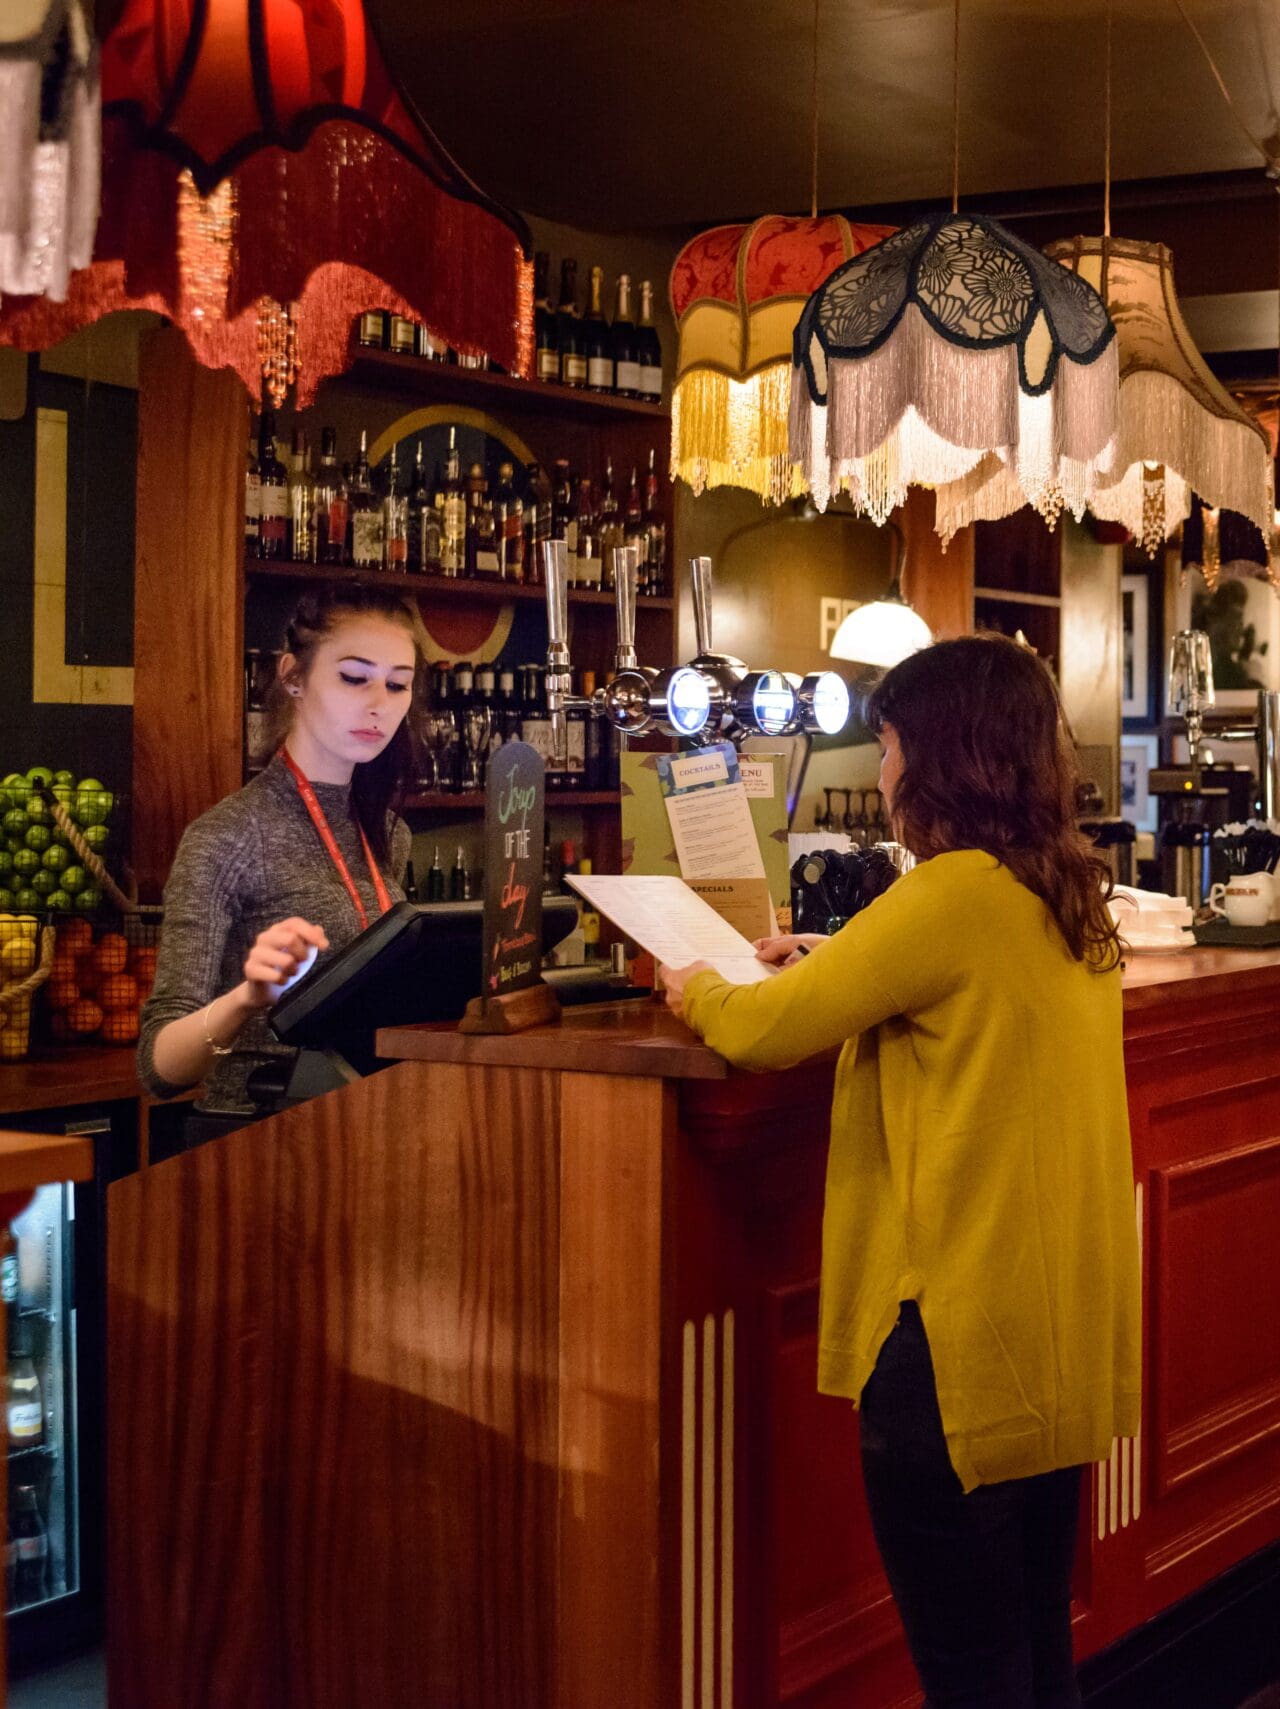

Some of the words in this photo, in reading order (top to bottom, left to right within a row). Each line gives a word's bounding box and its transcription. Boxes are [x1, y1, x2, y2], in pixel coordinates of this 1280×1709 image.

[679, 763, 721, 777] COCKTAILS
[741, 769, 762, 777] ENU
[504, 831, 515, 859] OF
[516, 829, 531, 859] THE
[500, 862, 531, 930] day
